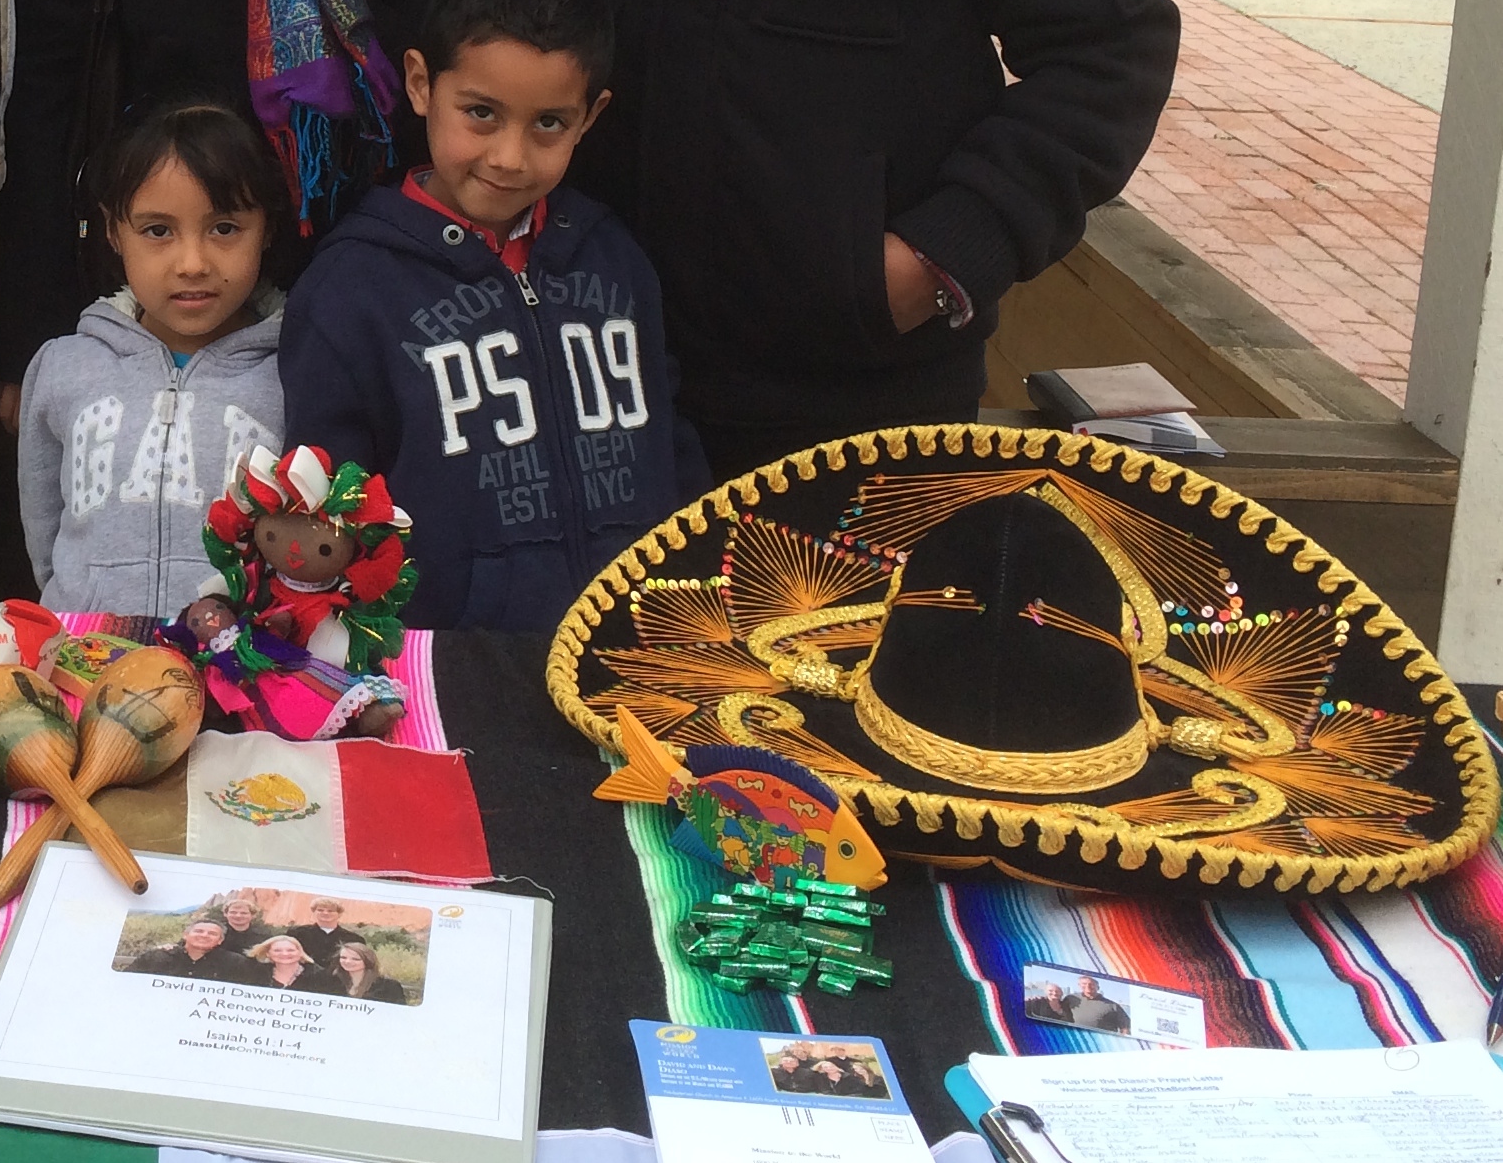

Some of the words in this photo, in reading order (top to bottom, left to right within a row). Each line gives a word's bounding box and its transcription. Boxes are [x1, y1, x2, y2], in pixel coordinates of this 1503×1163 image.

[423, 329, 539, 456] PS
[560, 318, 649, 431] 09
[479, 443, 550, 489] ATHL
[574, 430, 636, 472] DEPT
[497, 482, 557, 526] EST.
[583, 466, 635, 511] NYC
[151, 978, 194, 992] David
[198, 985, 225, 995] and
[231, 987, 274, 1002] Dawn
[280, 993, 323, 1007] Diaso
[328, 999, 376, 1015] Family
[197, 997, 210, 1007] A
[216, 999, 285, 1017] Renewed
[291, 1009, 323, 1023] City
[189, 1009, 202, 1019] A
[207, 1010, 266, 1027] Revived
[271, 1019, 326, 1034] Border
[178, 1039, 327, 1064] DiasoLifeOnTheBorder.org
[206, 1030, 248, 1043] Isaiah
[253, 1036, 302, 1050] 61:1-4
